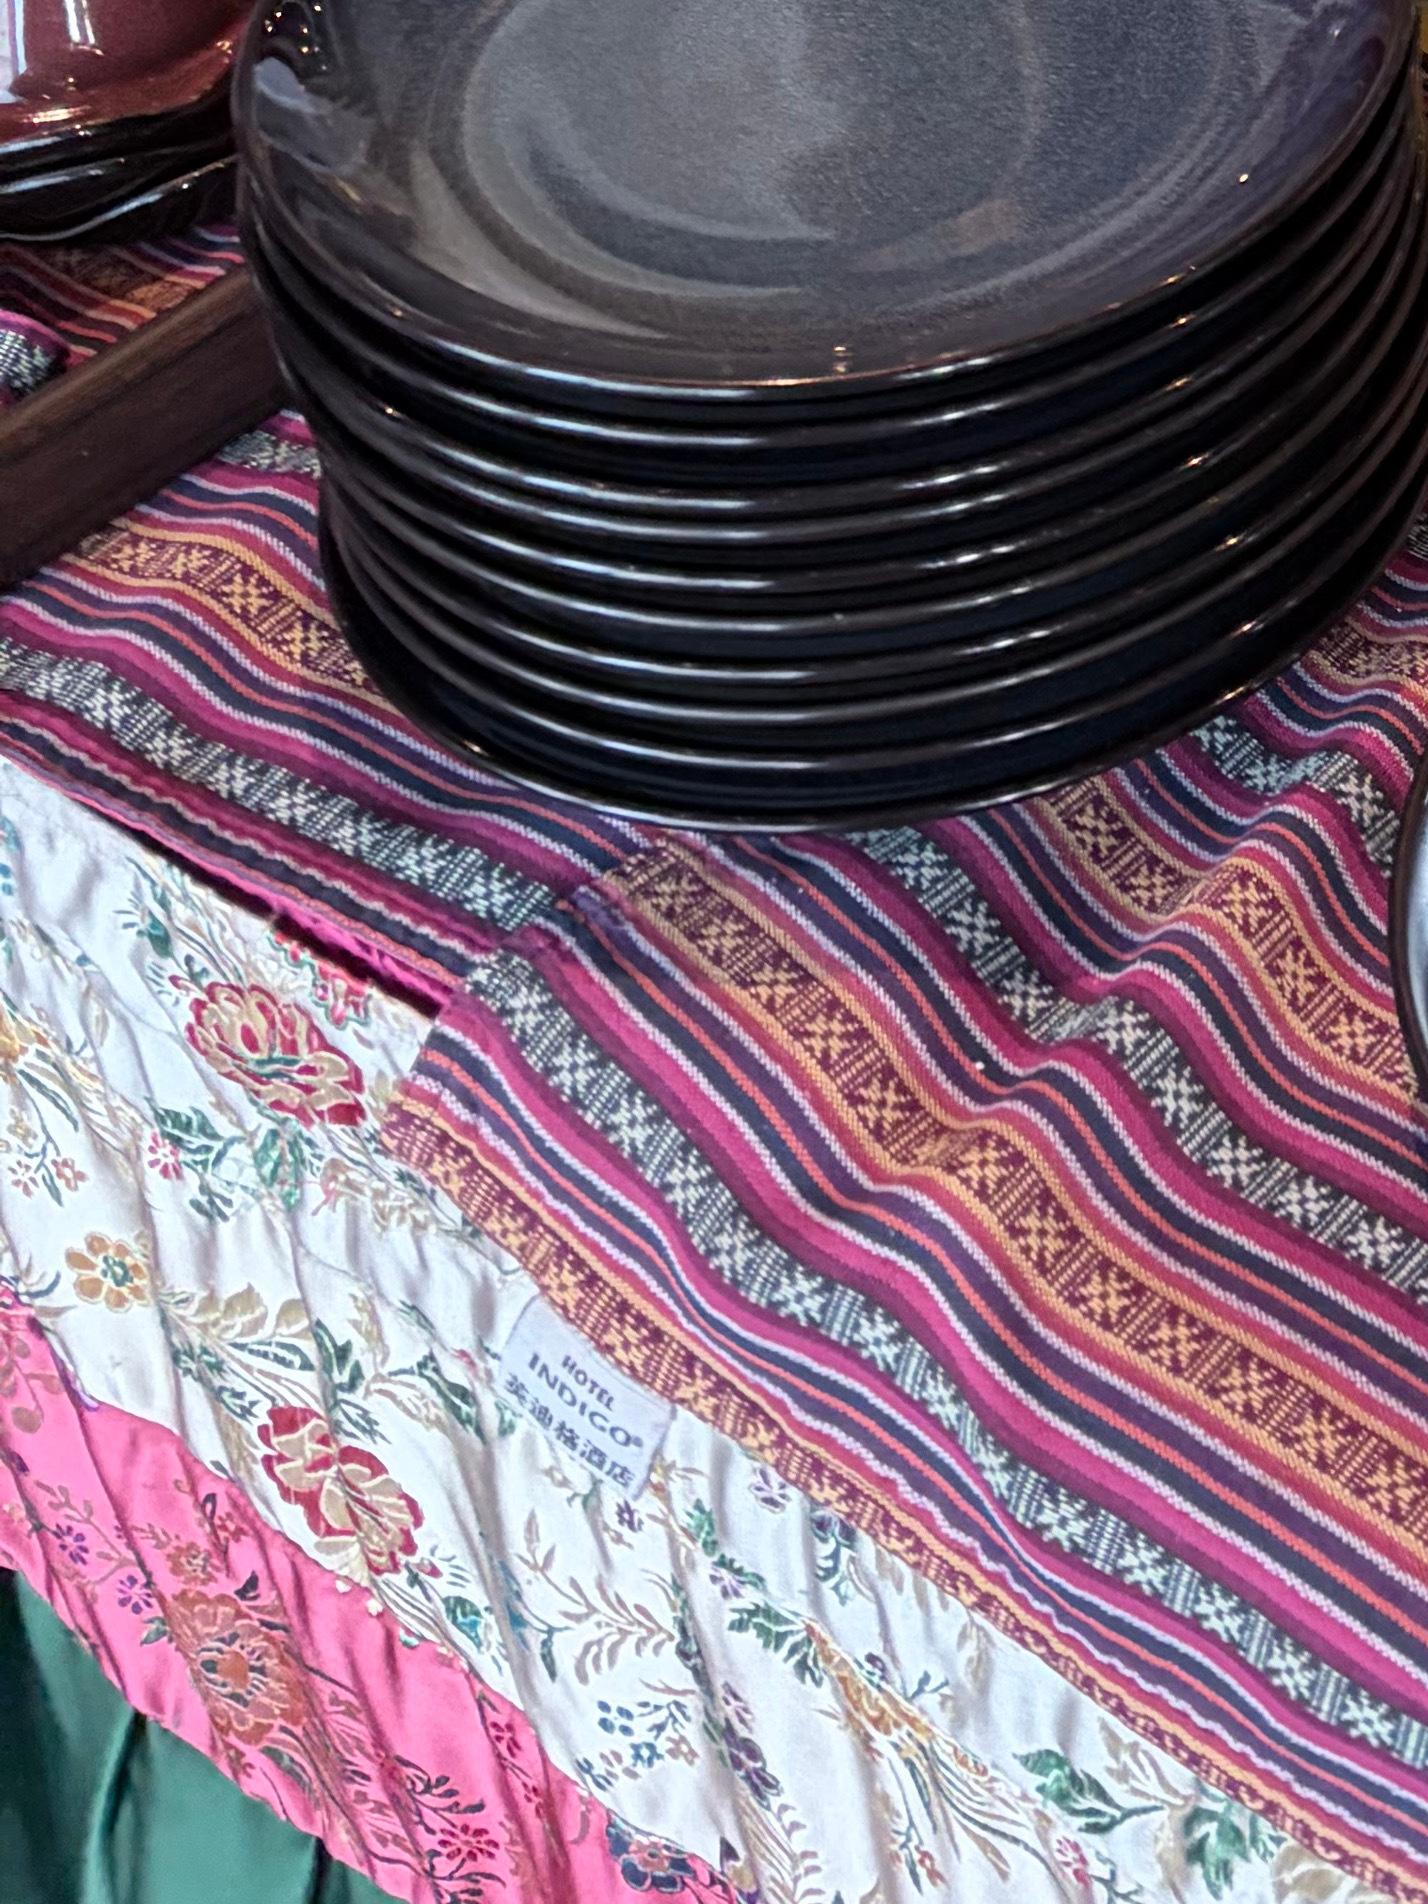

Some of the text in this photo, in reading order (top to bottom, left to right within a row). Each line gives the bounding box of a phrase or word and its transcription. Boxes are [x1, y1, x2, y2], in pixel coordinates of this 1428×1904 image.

[505, 1372, 636, 1489] 英迪格酒店
[528, 1352, 633, 1448] INDIGO
[561, 1355, 615, 1413] HOTEL
